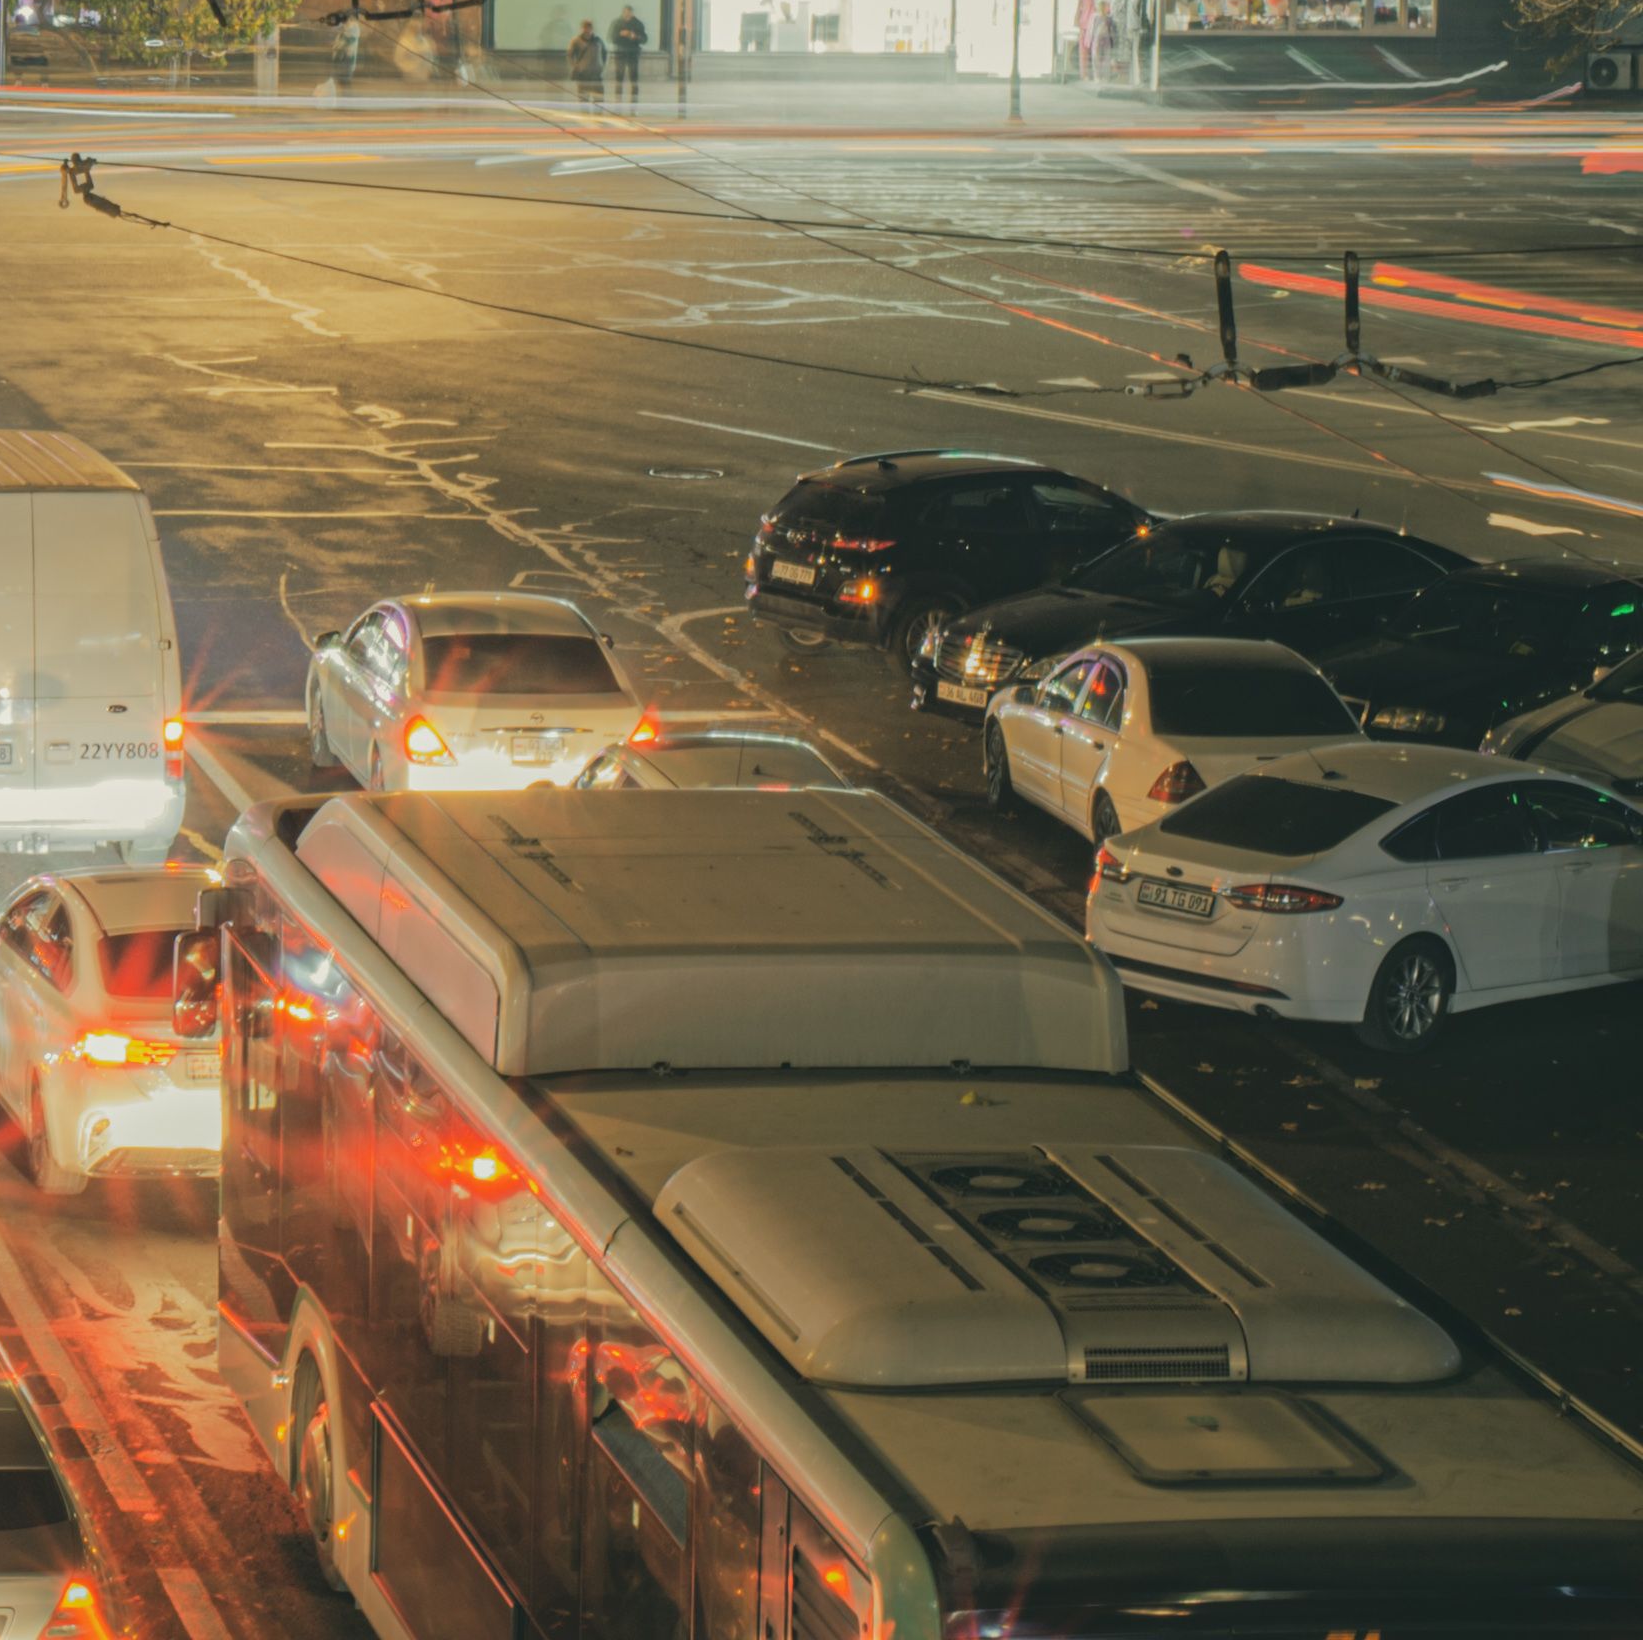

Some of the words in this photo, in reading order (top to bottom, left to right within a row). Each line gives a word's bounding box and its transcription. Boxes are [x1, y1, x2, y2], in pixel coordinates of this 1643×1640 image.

[80, 742, 159, 760] 22YY808
[1154, 887, 1168, 903] 91
[1172, 891, 1186, 908] TG
[1188, 895, 1209, 912] 091
